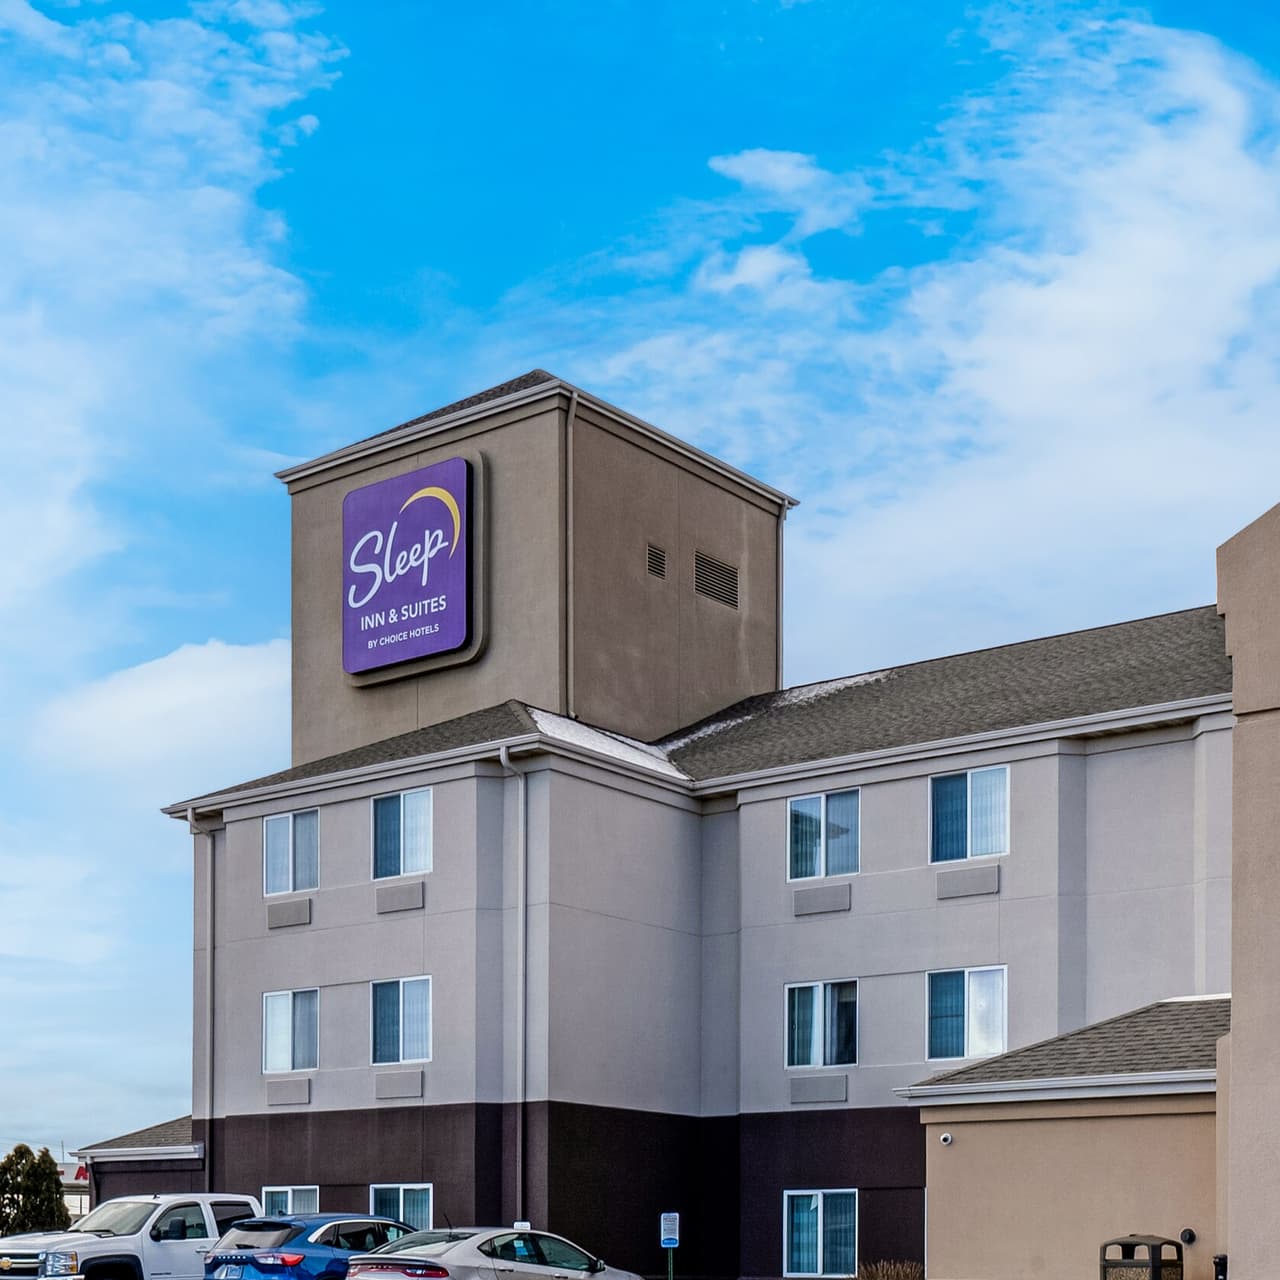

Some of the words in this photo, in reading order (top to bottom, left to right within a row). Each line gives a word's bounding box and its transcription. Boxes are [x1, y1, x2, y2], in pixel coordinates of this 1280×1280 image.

[348, 521, 449, 608] Sleep
[361, 612, 386, 631] INN
[388, 610, 399, 624] &
[400, 595, 447, 621] SUITES
[367, 639, 378, 649] BY
[379, 631, 408, 647] CHOICE
[409, 623, 440, 638] HOTELS
